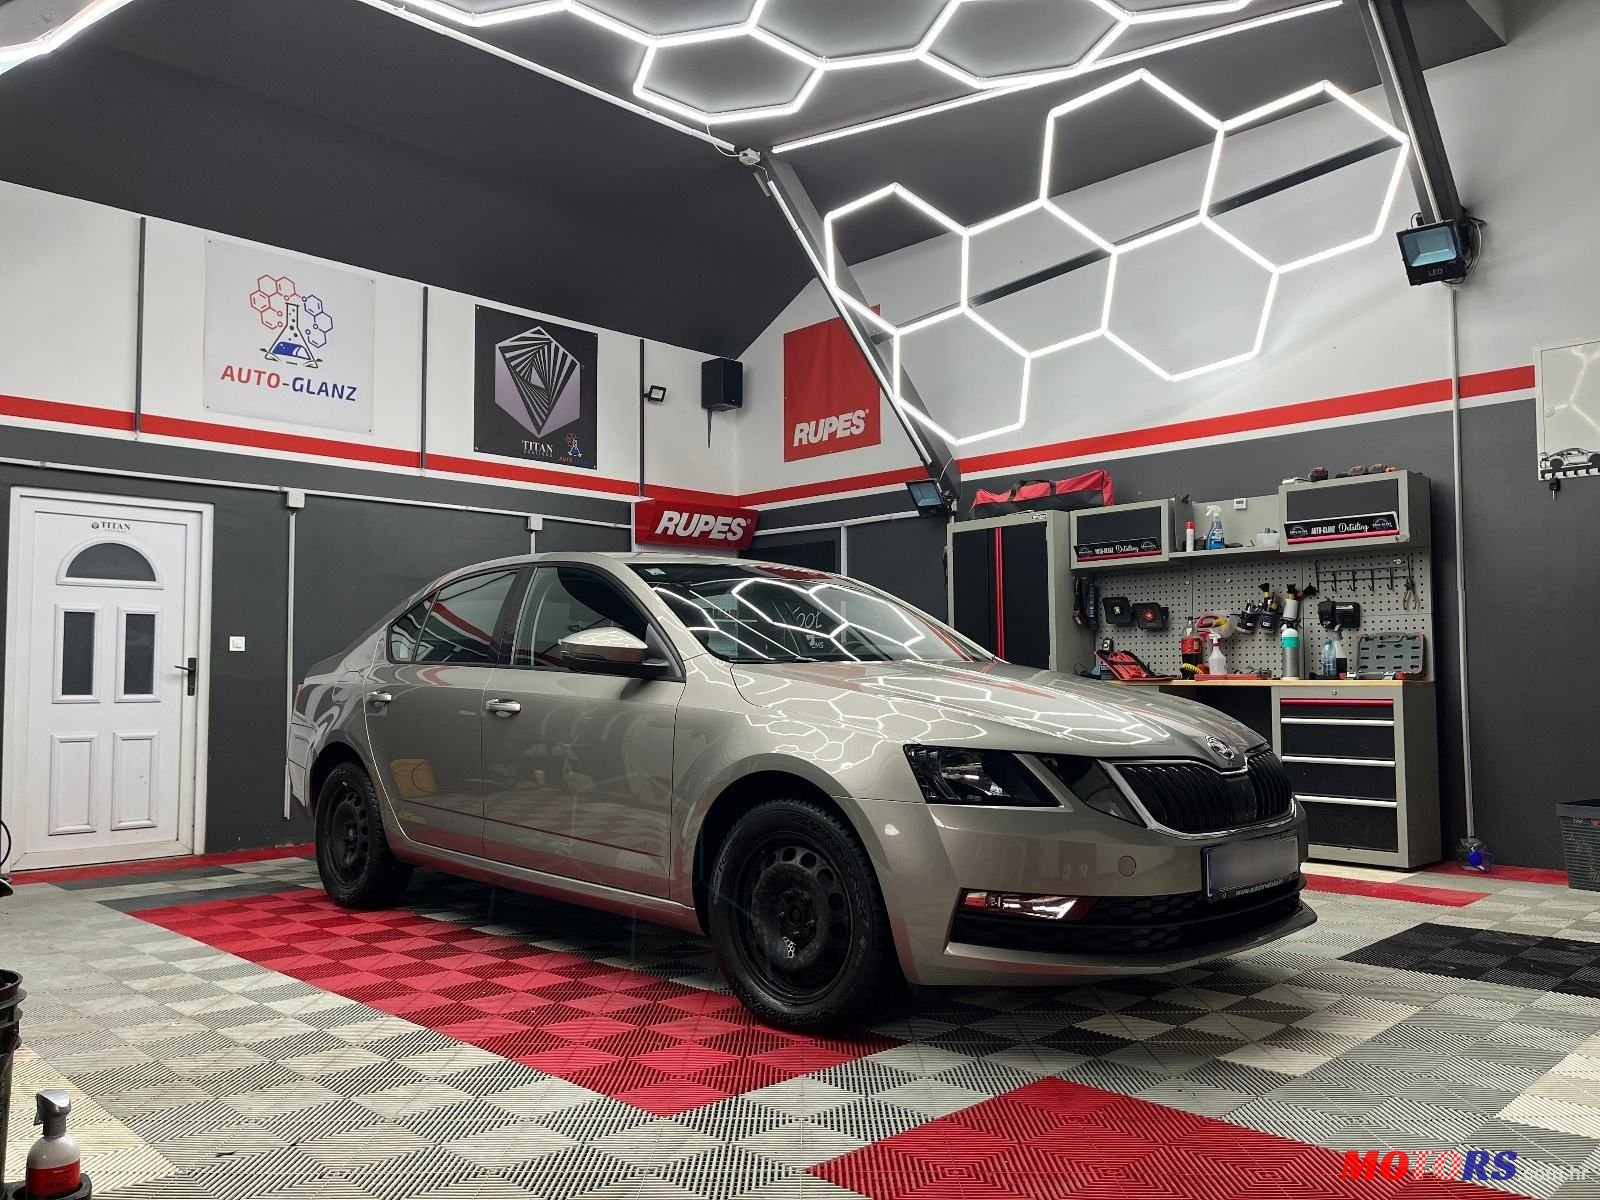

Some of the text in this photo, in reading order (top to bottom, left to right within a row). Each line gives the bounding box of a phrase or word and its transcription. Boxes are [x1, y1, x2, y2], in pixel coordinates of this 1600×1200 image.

[1428, 268, 1443, 276] LED
[220, 365, 358, 402] AUTO-GLANZ
[521, 440, 553, 453] TITAN
[101, 521, 130, 530] TITAN
[1338, 522, 1370, 533] Detailing
